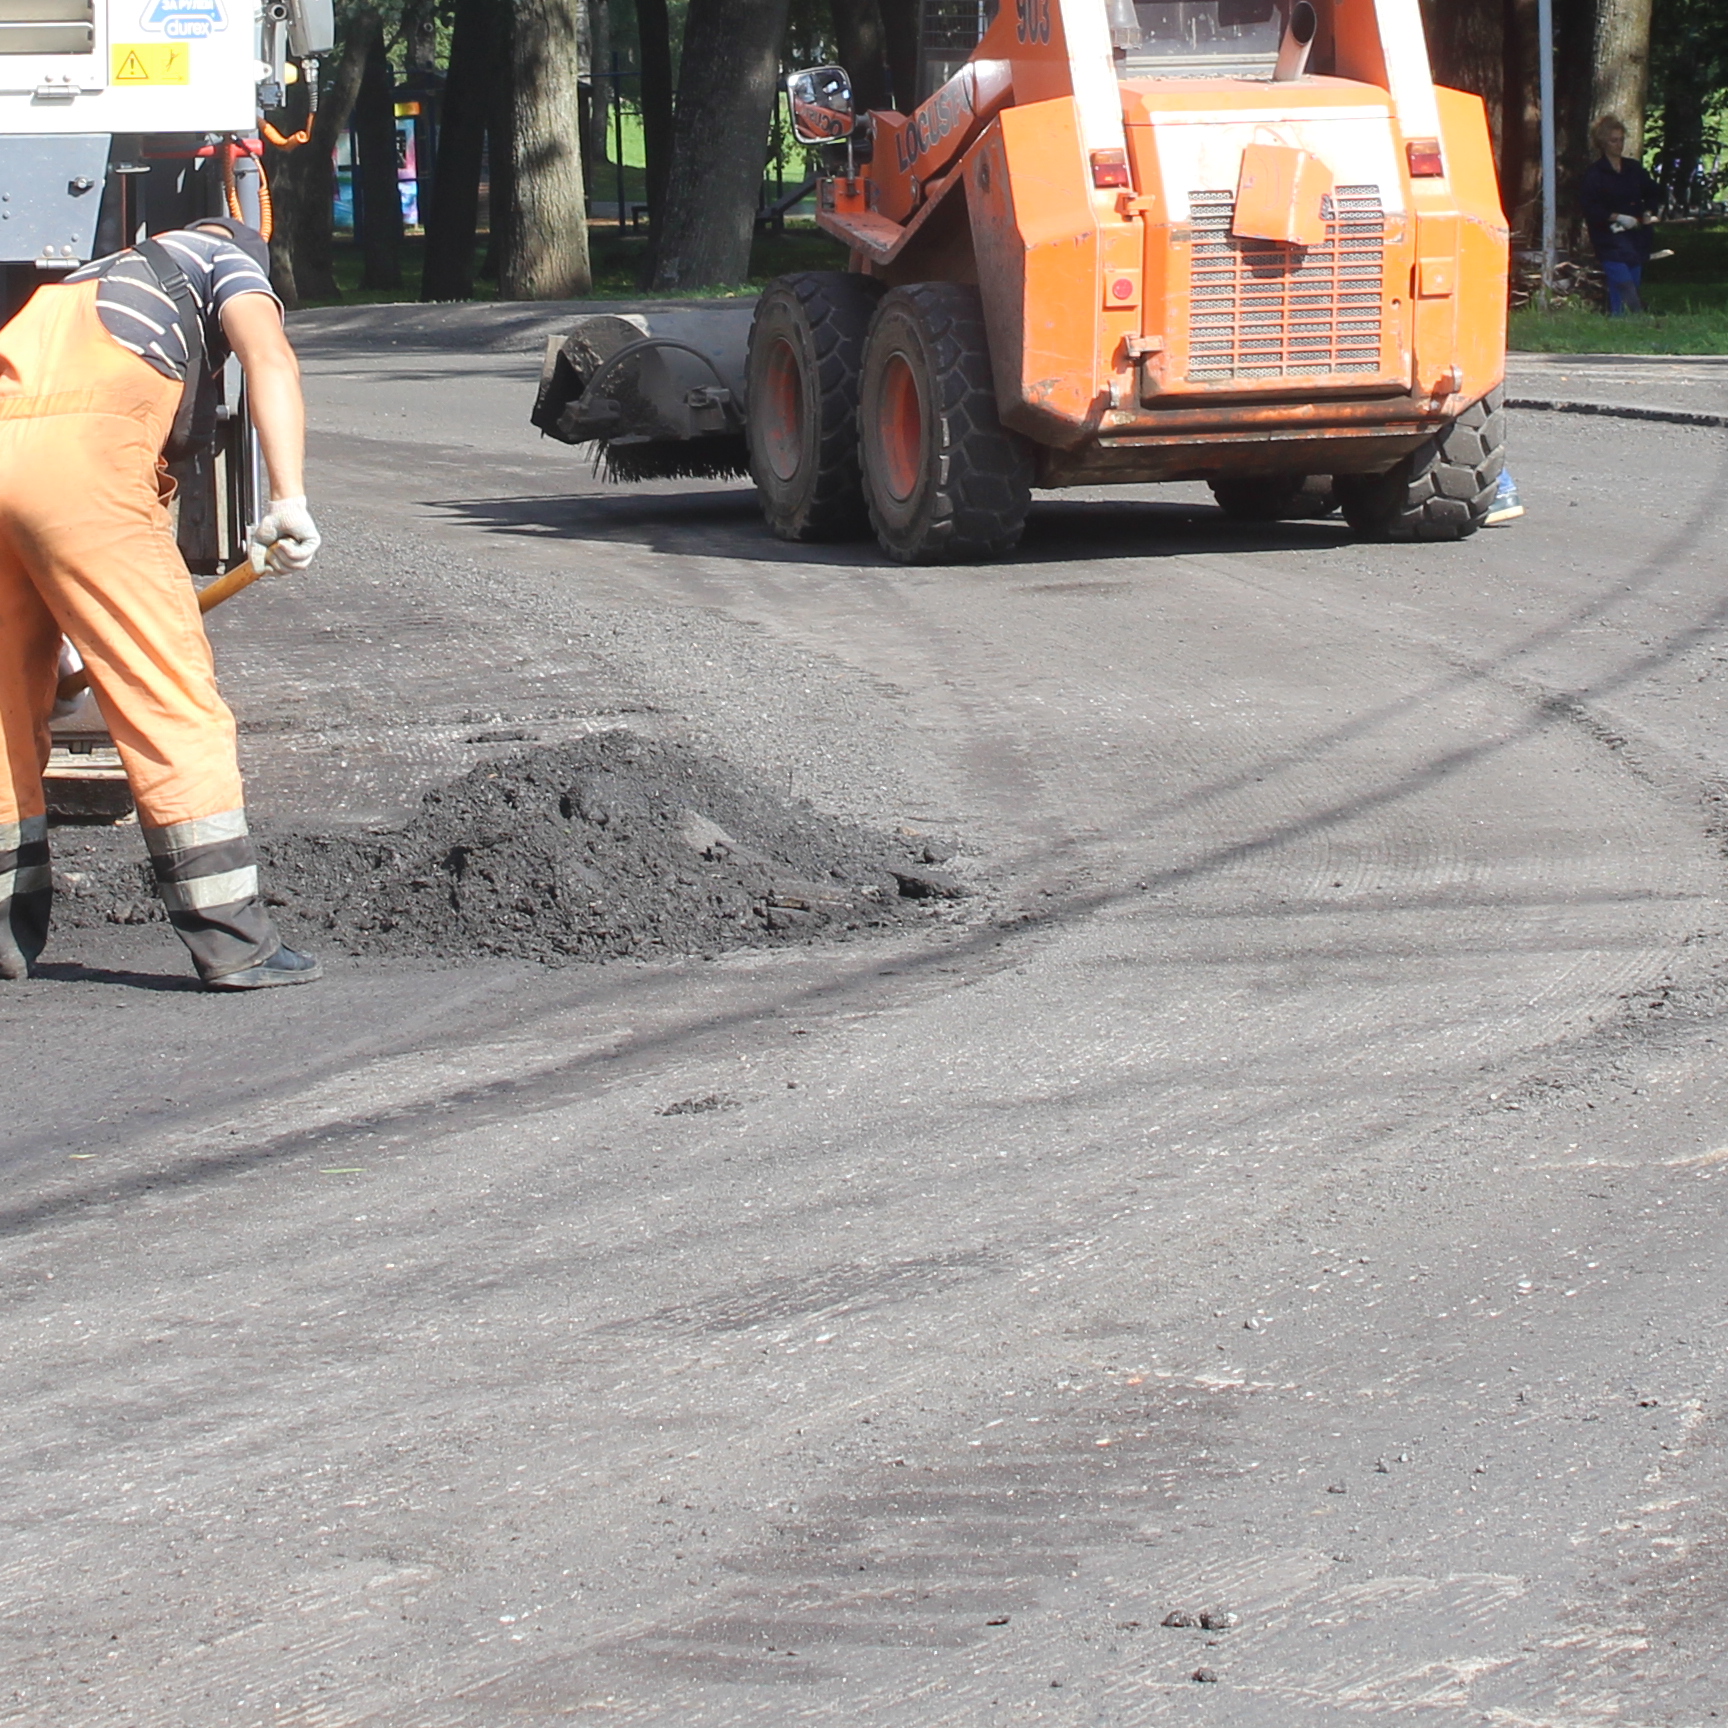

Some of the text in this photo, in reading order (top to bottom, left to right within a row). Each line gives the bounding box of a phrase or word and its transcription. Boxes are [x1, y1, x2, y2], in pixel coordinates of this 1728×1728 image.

[161, 0, 178, 10] ЗА
[167, 18, 210, 36] durex
[894, 79, 964, 175] LOCUST
